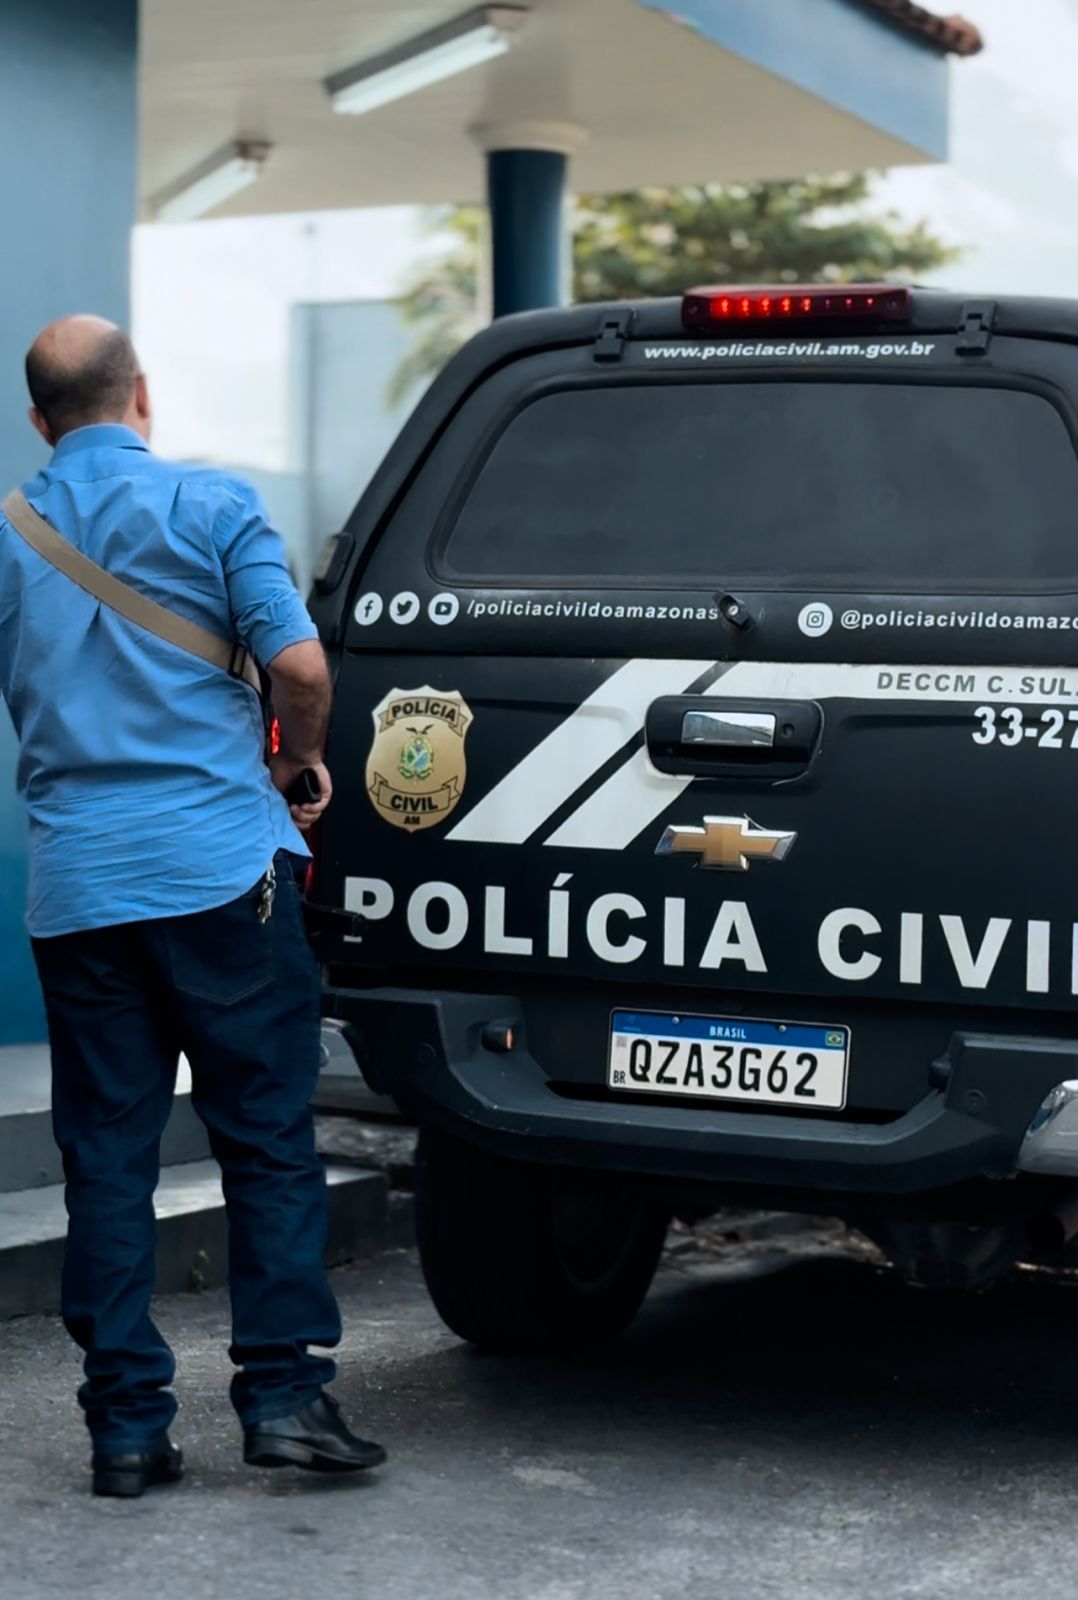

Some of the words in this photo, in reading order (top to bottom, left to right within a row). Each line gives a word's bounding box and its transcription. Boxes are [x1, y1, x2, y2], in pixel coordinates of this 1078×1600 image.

[644, 341, 935, 360] www.policiacivil.am.gov.br
[466, 599, 718, 620] /policiacivildoamazonas
[876, 672, 976, 693] DECCM
[391, 699, 456, 722] POLÍCIA
[391, 795, 438, 812] CIVIL
[403, 815, 421, 825] AM
[343, 872, 769, 974] POLÍCIA
[817, 907, 1078, 995] CIVI
[709, 1026, 747, 1039] BRASIL
[613, 1070, 626, 1084] BR
[629, 1038, 818, 1097] QZA3G62
